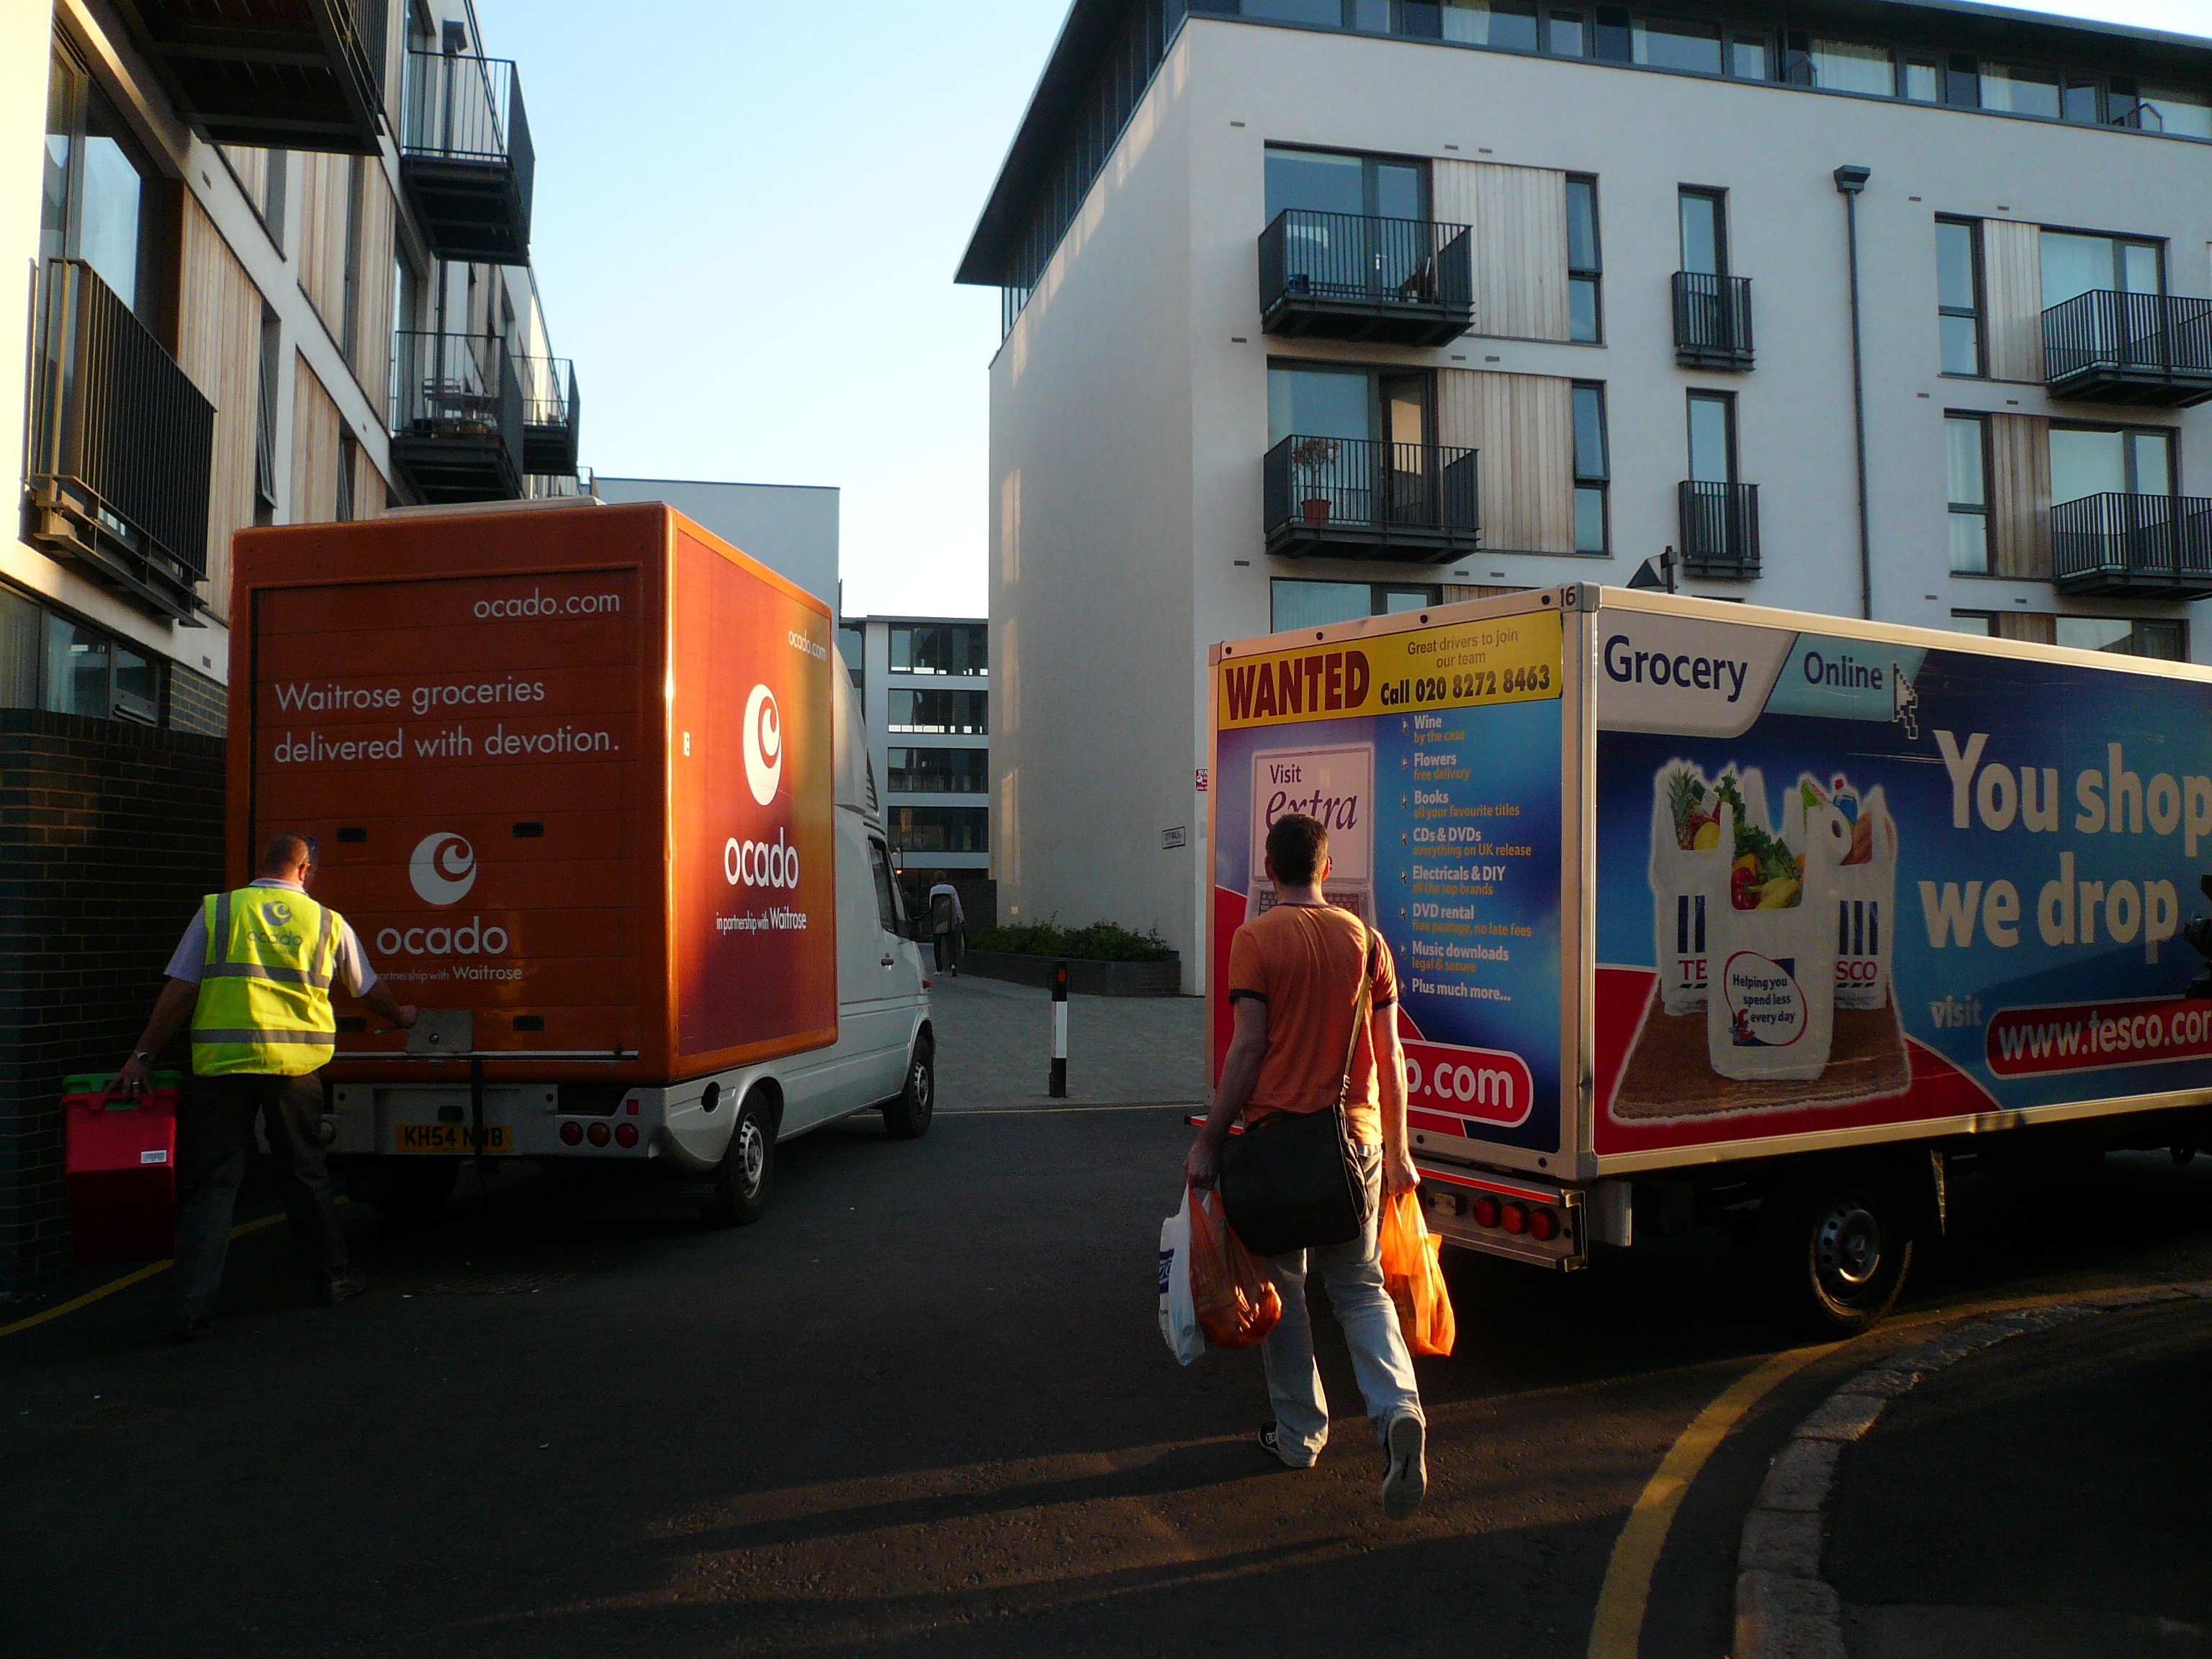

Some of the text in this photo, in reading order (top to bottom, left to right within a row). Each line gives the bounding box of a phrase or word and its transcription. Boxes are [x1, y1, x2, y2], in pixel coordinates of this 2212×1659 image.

[474, 588, 620, 619] ocado.com
[1560, 585, 1576, 607] 16
[788, 629, 826, 661] ocado.com
[1408, 629, 1519, 655] Great drivers to join
[1437, 652, 1485, 668] our team
[1604, 634, 1748, 703] Grocery
[1804, 650, 1883, 691] Online
[275, 676, 545, 715] Waitrose groceries
[1225, 649, 1370, 721] WANTED
[1380, 664, 1550, 706] Call 020 8272 8463
[1414, 714, 1442, 729] Wine
[274, 724, 619, 763] delivered with devotion.
[1414, 730, 1465, 745] by the case
[1414, 752, 1457, 767] Flowers
[1269, 763, 1302, 784] Visit
[1413, 768, 1470, 781] free delivery
[1414, 790, 1449, 804] Books
[1933, 729, 2212, 857] You shop
[1413, 804, 1520, 820] all your favourite titles
[1413, 827, 1482, 842] CDs & DVDs
[724, 827, 799, 889] ocado
[1413, 843, 1532, 858] everything on UK release
[1413, 865, 1506, 881] Electricals & DIY
[1412, 882, 1493, 896] all the top brands
[1413, 902, 1475, 920] DVD rental
[1918, 851, 2178, 964] we drop
[716, 905, 806, 935] in partnership with Waitrose
[1412, 920, 1431, 931] free
[1475, 925, 1487, 934] no
[1489, 922, 1509, 935] late
[1511, 923, 1532, 936] fees
[248, 930, 303, 945] ocado
[377, 916, 508, 956] ocado
[1412, 940, 1510, 961] Music downloads
[430, 969, 449, 980] with
[452, 965, 522, 980] Waitrose
[1412, 956, 1476, 973] legal & secure
[1836, 960, 1878, 981] SCO
[1412, 978, 1435, 994] Plus
[1437, 982, 1468, 997] much
[1733, 974, 1788, 990] Helping you
[1743, 994, 1791, 1007] spend less
[1929, 994, 1983, 1028] visit
[1750, 1010, 1796, 1024] every day
[1406, 1057, 1514, 1109] o.com
[404, 1126, 457, 1147] KH54
